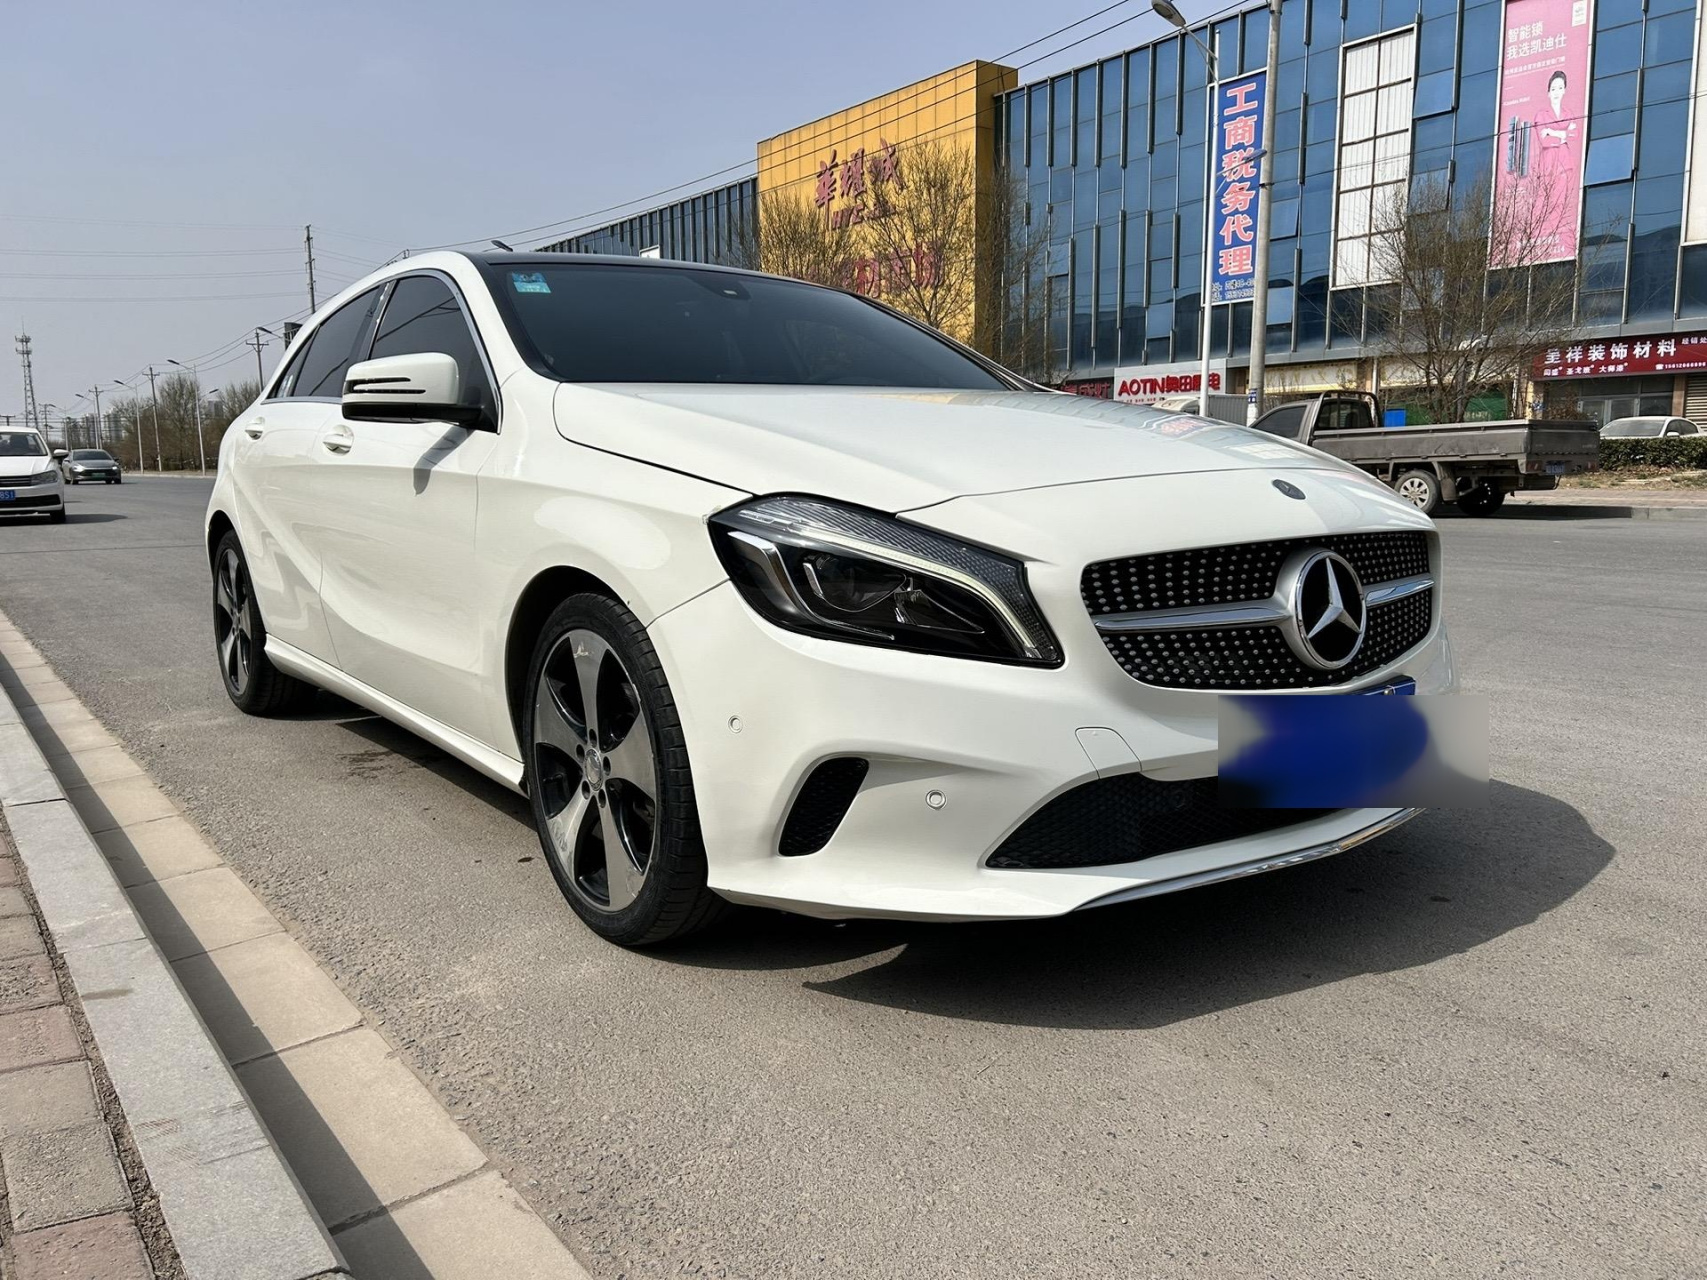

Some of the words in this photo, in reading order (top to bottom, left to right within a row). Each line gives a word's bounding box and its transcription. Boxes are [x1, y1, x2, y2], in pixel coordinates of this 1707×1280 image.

[1508, 21, 1544, 43] 智能锁
[1507, 33, 1567, 60] 我选凯迪仕
[1219, 83, 1258, 276] 工商税务代理
